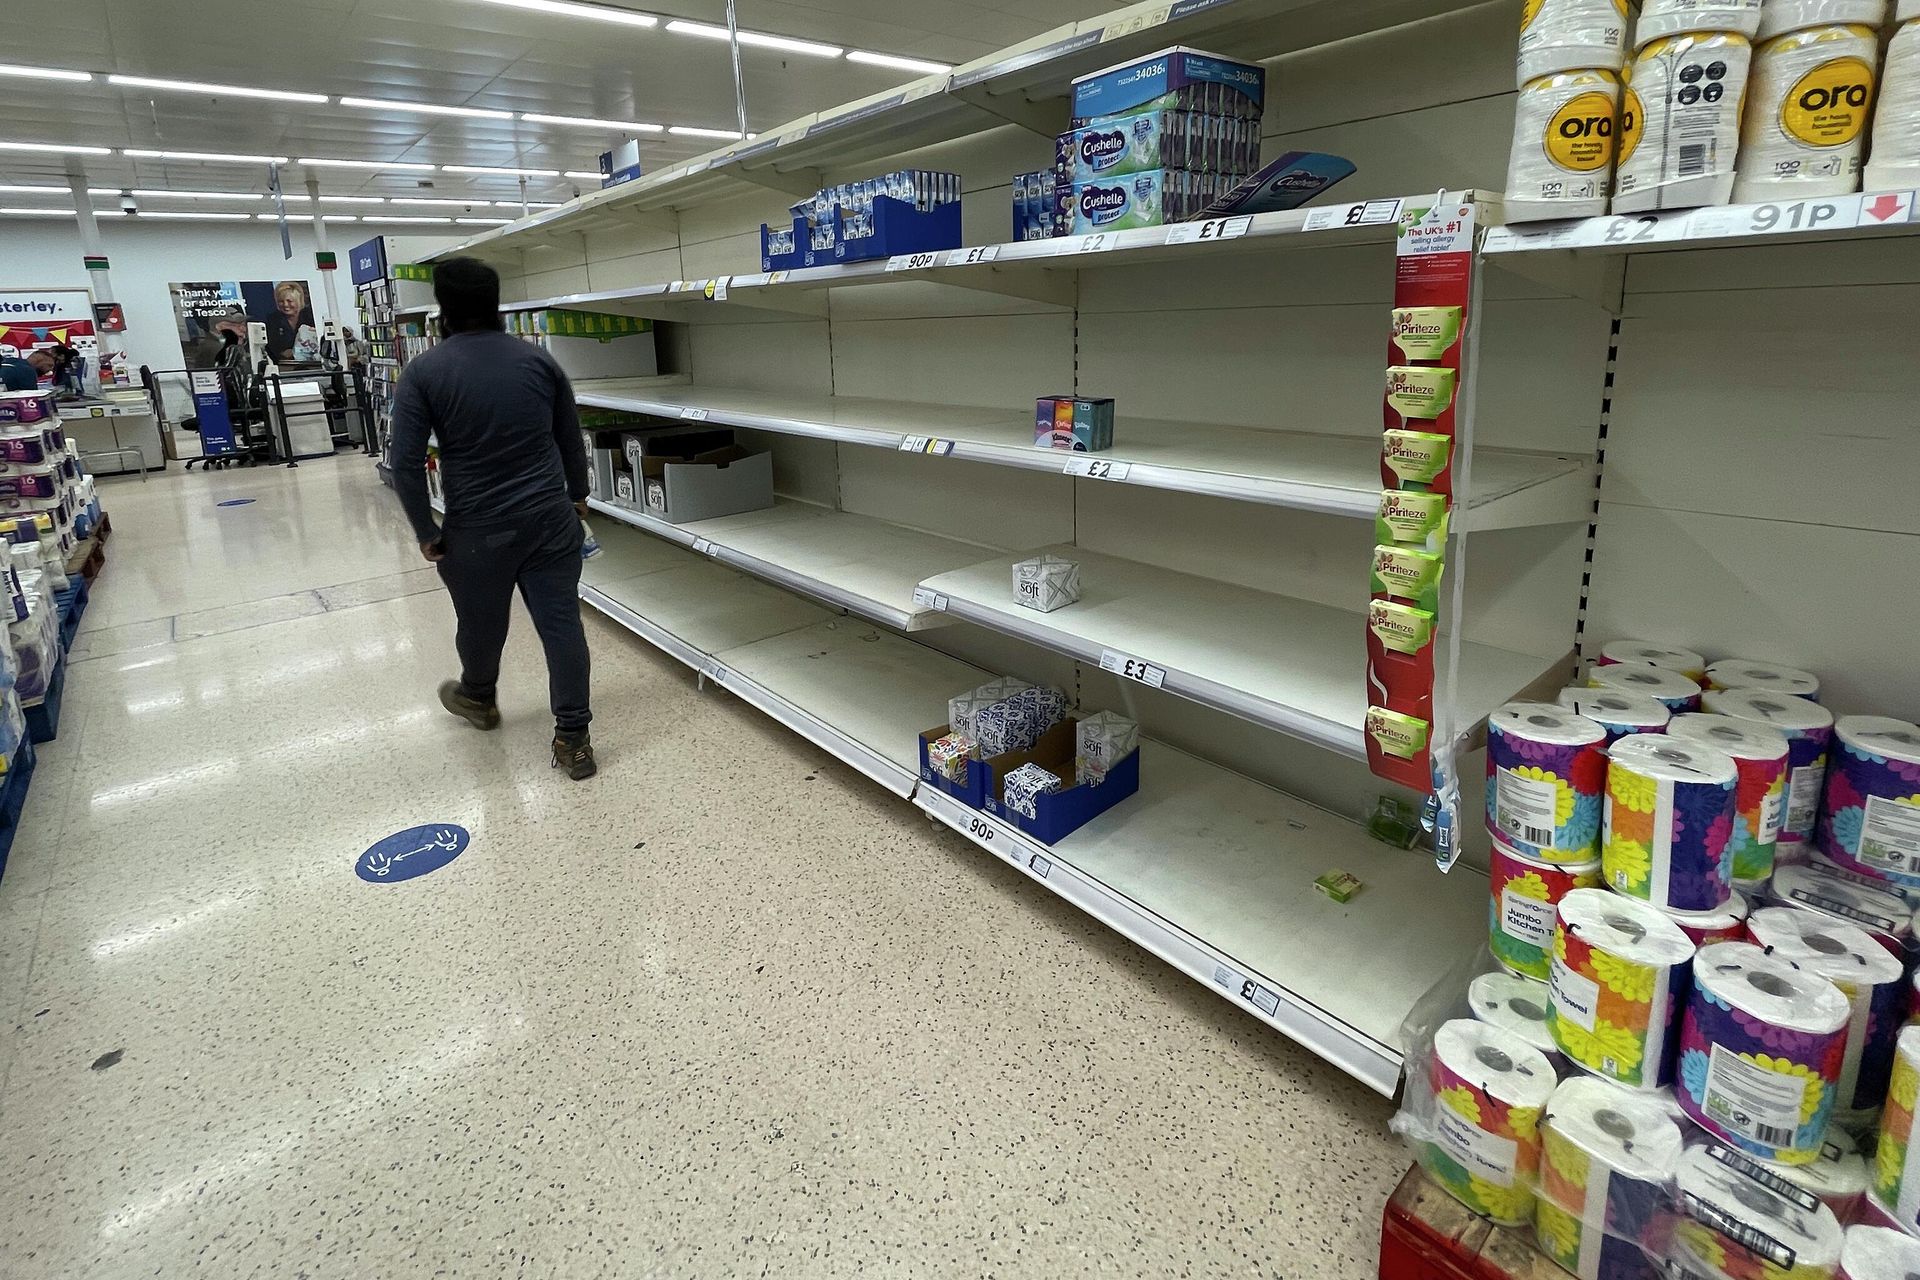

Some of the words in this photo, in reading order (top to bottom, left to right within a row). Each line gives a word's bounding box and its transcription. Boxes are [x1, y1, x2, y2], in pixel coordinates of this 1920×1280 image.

[1800, 84, 1866, 111] ora
[1560, 117, 1612, 138] ora
[1084, 138, 1122, 156] Cushelle
[1097, 155, 1120, 168] protect
[1542, 182, 1562, 191] 100
[1083, 193, 1123, 209] Cushelle
[1097, 210, 1120, 222] protect
[1750, 203, 1836, 231] 91p
[1199, 219, 1226, 238] £1
[1408, 228, 1422, 238] The
[1446, 221, 1461, 233] #1
[1604, 216, 1658, 243] £2
[1080, 234, 1104, 251] £2
[1433, 235, 1455, 243] allergy
[909, 254, 932, 268] 90p
[177, 288, 211, 298] Thank
[212, 289, 231, 299] you
[180, 299, 197, 308] for
[199, 298, 247, 308] shopping
[182, 309, 194, 318] at
[195, 308, 227, 317] Tesco
[1401, 324, 1440, 335] Piriteze
[1395, 383, 1434, 395] Piriteze
[21, 399, 36, 409] 16
[9, 441, 24, 450] 16
[1392, 448, 1430, 460] Piriteze
[1087, 461, 1111, 477] £2
[22, 476, 35, 485] 16
[1389, 507, 1426, 519] Piriteze
[1383, 562, 1419, 577] Piriteze
[1378, 618, 1414, 633] Piriteze
[1124, 660, 1147, 680] £3
[1376, 724, 1410, 741] Piriteze
[969, 818, 994, 840] 90p
[1508, 908, 1541, 924] Jumbo
[1508, 915, 1544, 934] Kitchen
[1240, 980, 1255, 1001] £
[1560, 989, 1588, 1014] Towel
